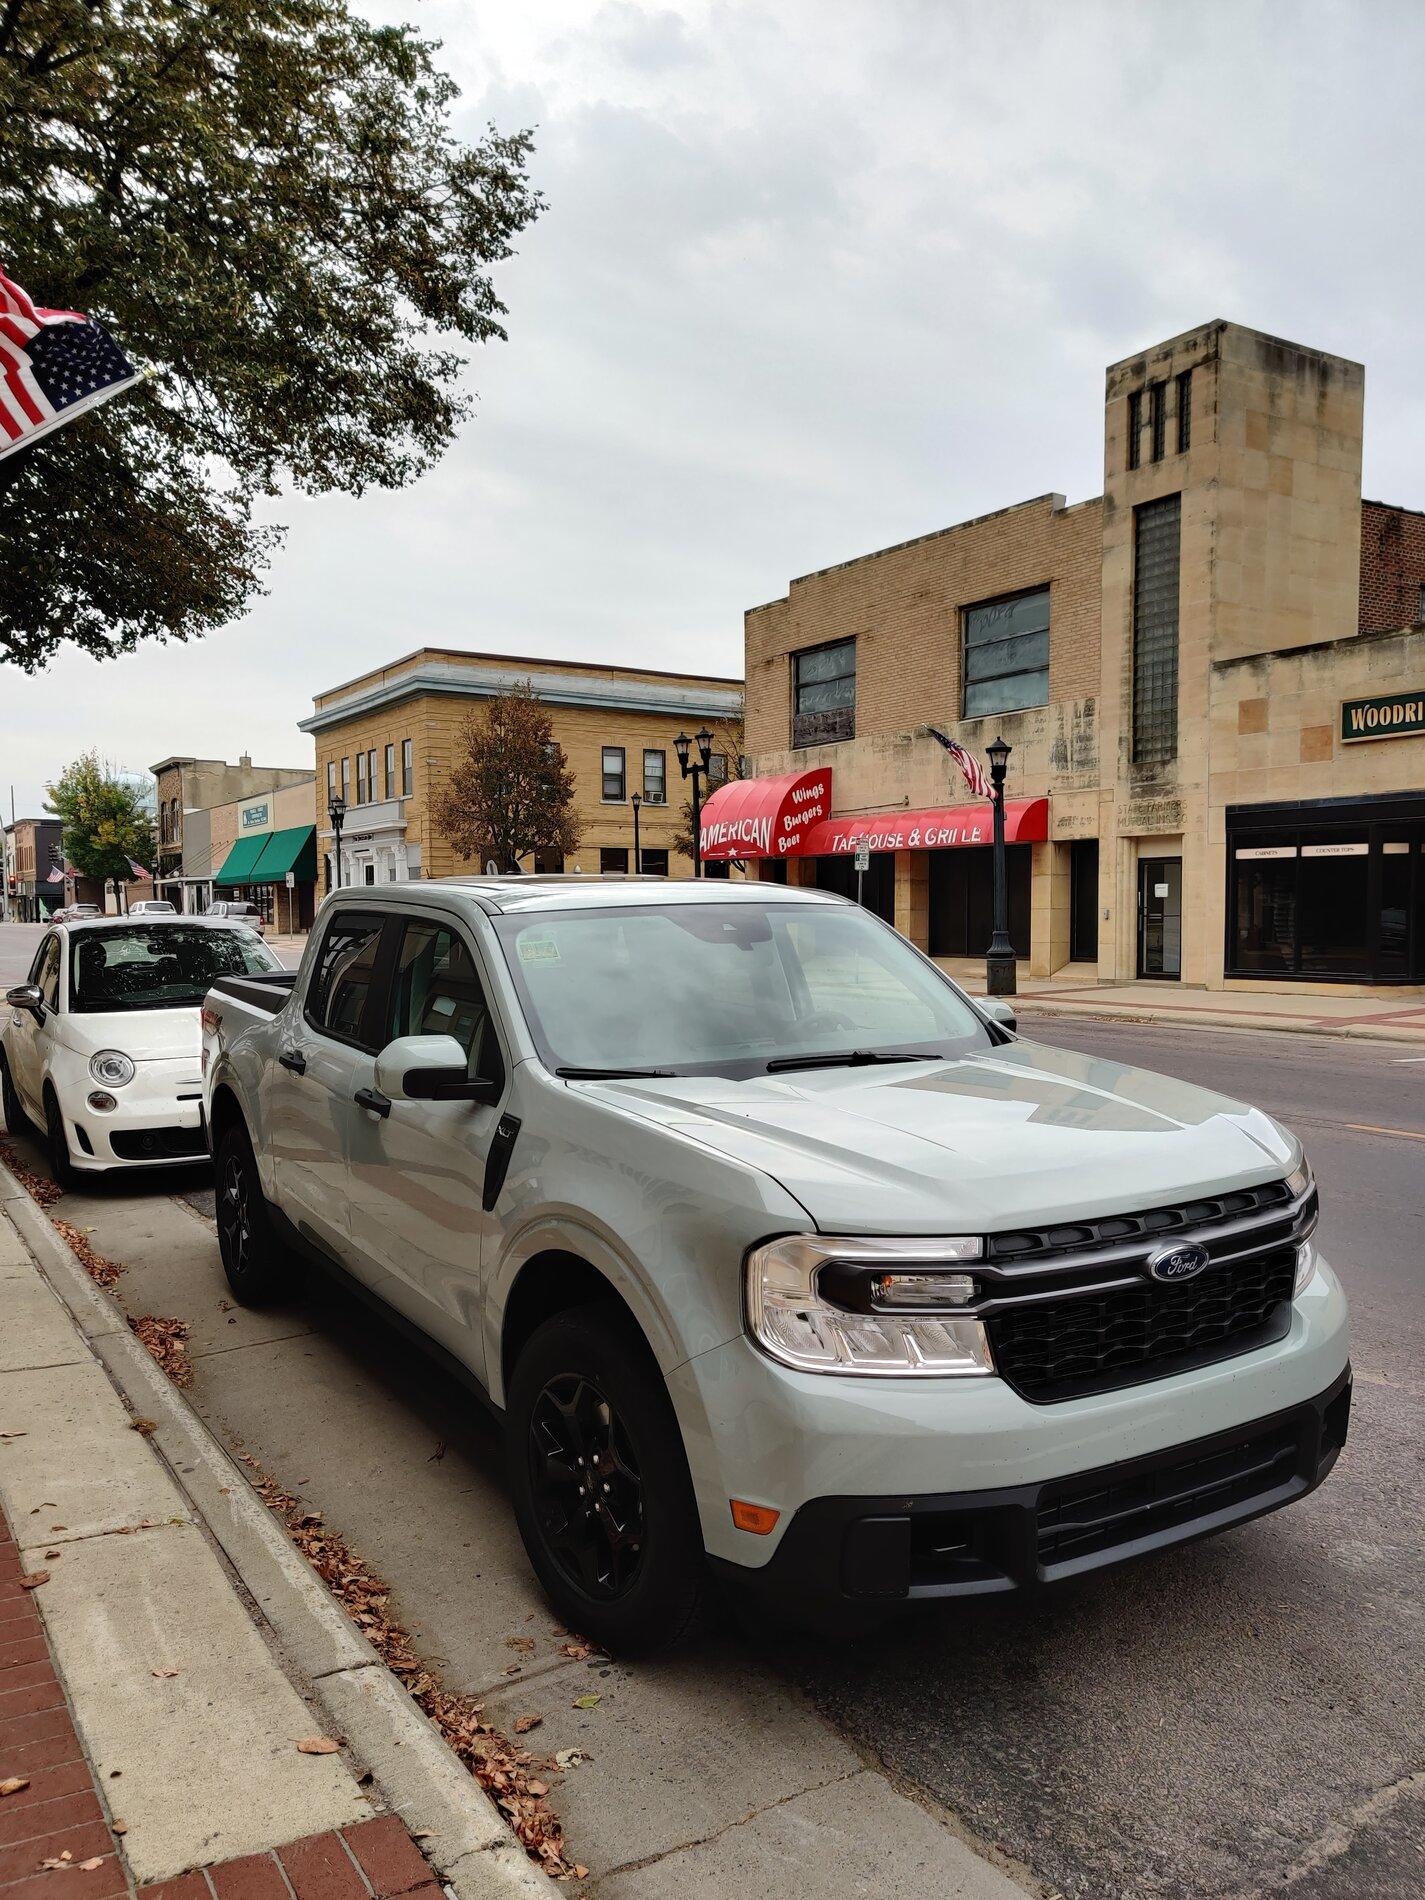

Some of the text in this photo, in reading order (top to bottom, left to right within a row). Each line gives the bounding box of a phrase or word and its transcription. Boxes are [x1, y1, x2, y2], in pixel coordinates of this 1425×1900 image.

[1351, 701, 1424, 731] WOODRI
[792, 783, 825, 805] Wings
[783, 804, 823, 832] Burgers
[1117, 803, 1142, 814] STATE
[700, 816, 773, 854] AMERICAN
[778, 833, 801, 853] Beer
[908, 828, 921, 847] &
[1167, 1255, 1198, 1275] Ford
